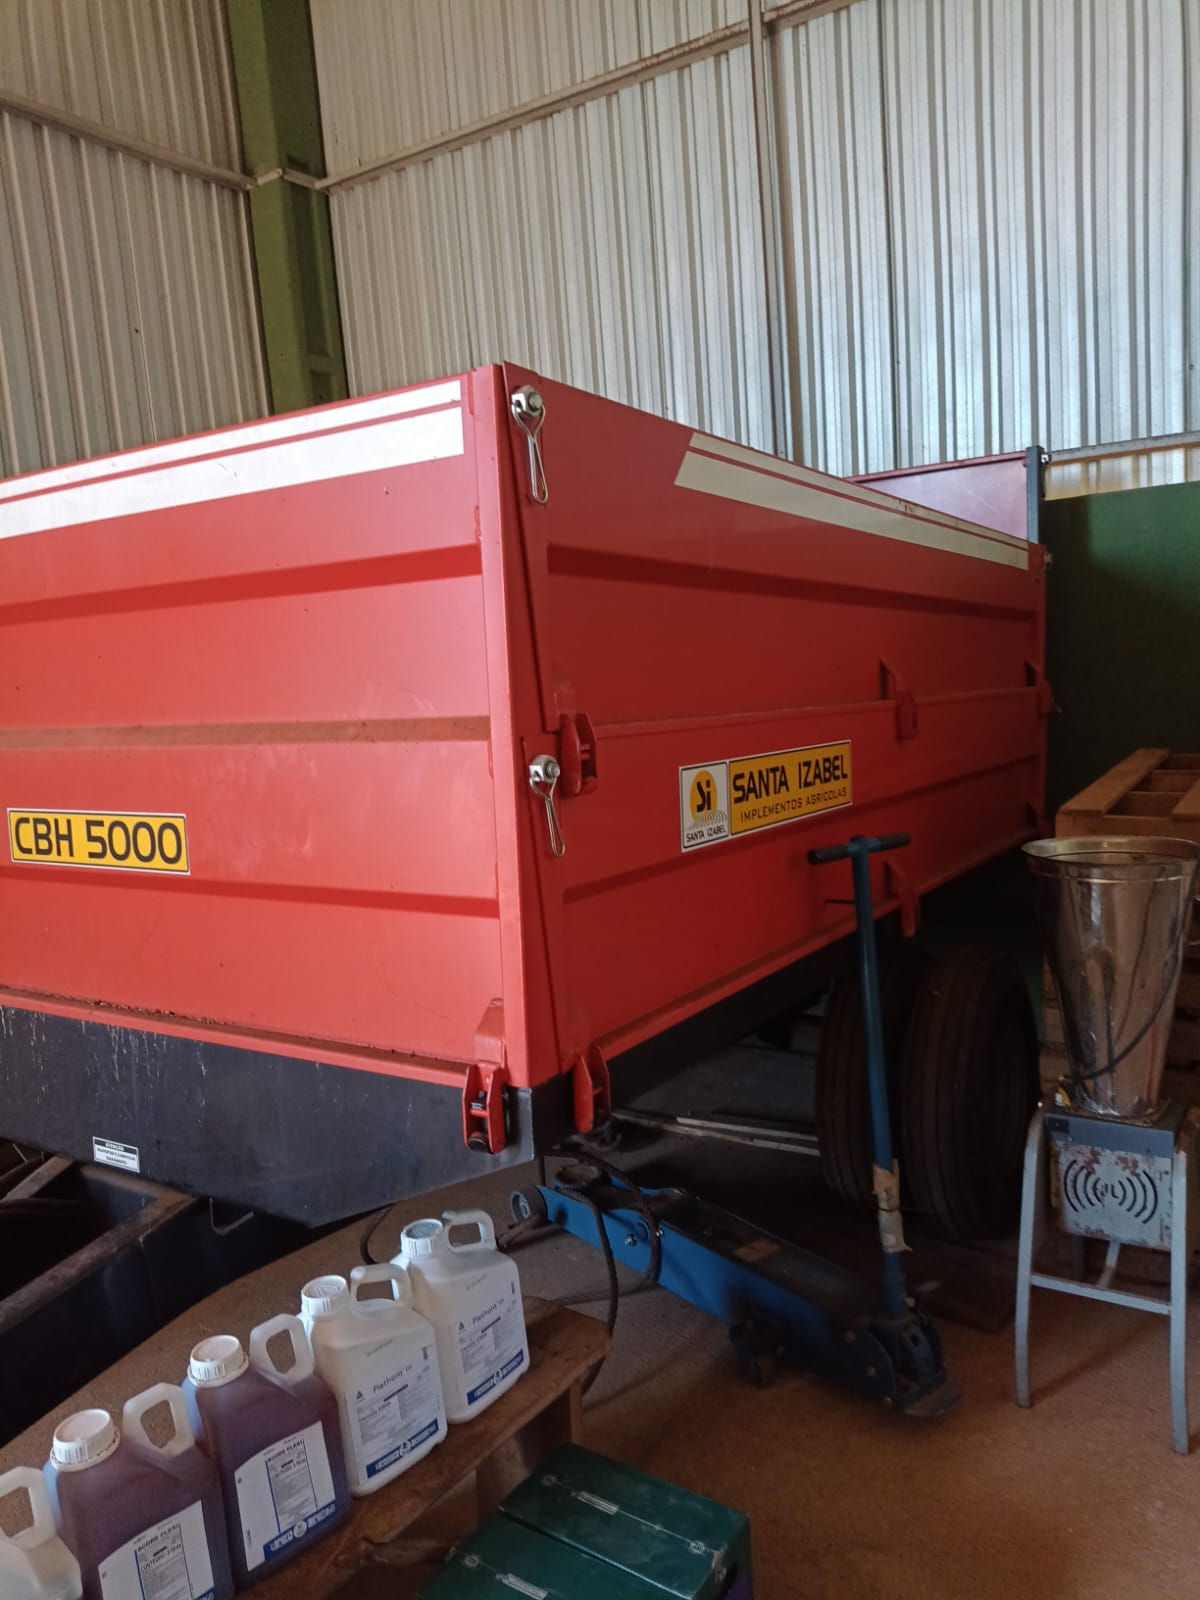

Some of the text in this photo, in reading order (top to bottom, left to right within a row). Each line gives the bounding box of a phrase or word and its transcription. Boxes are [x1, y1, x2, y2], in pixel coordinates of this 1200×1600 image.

[733, 754, 848, 804] SANTA IZABEL
[741, 798, 803, 824] IMPLEMENTOS
[15, 817, 182, 865] CBH 5000
[686, 825, 727, 843] SANTA IZABEL
[372, 1370, 403, 1393] Plethora
